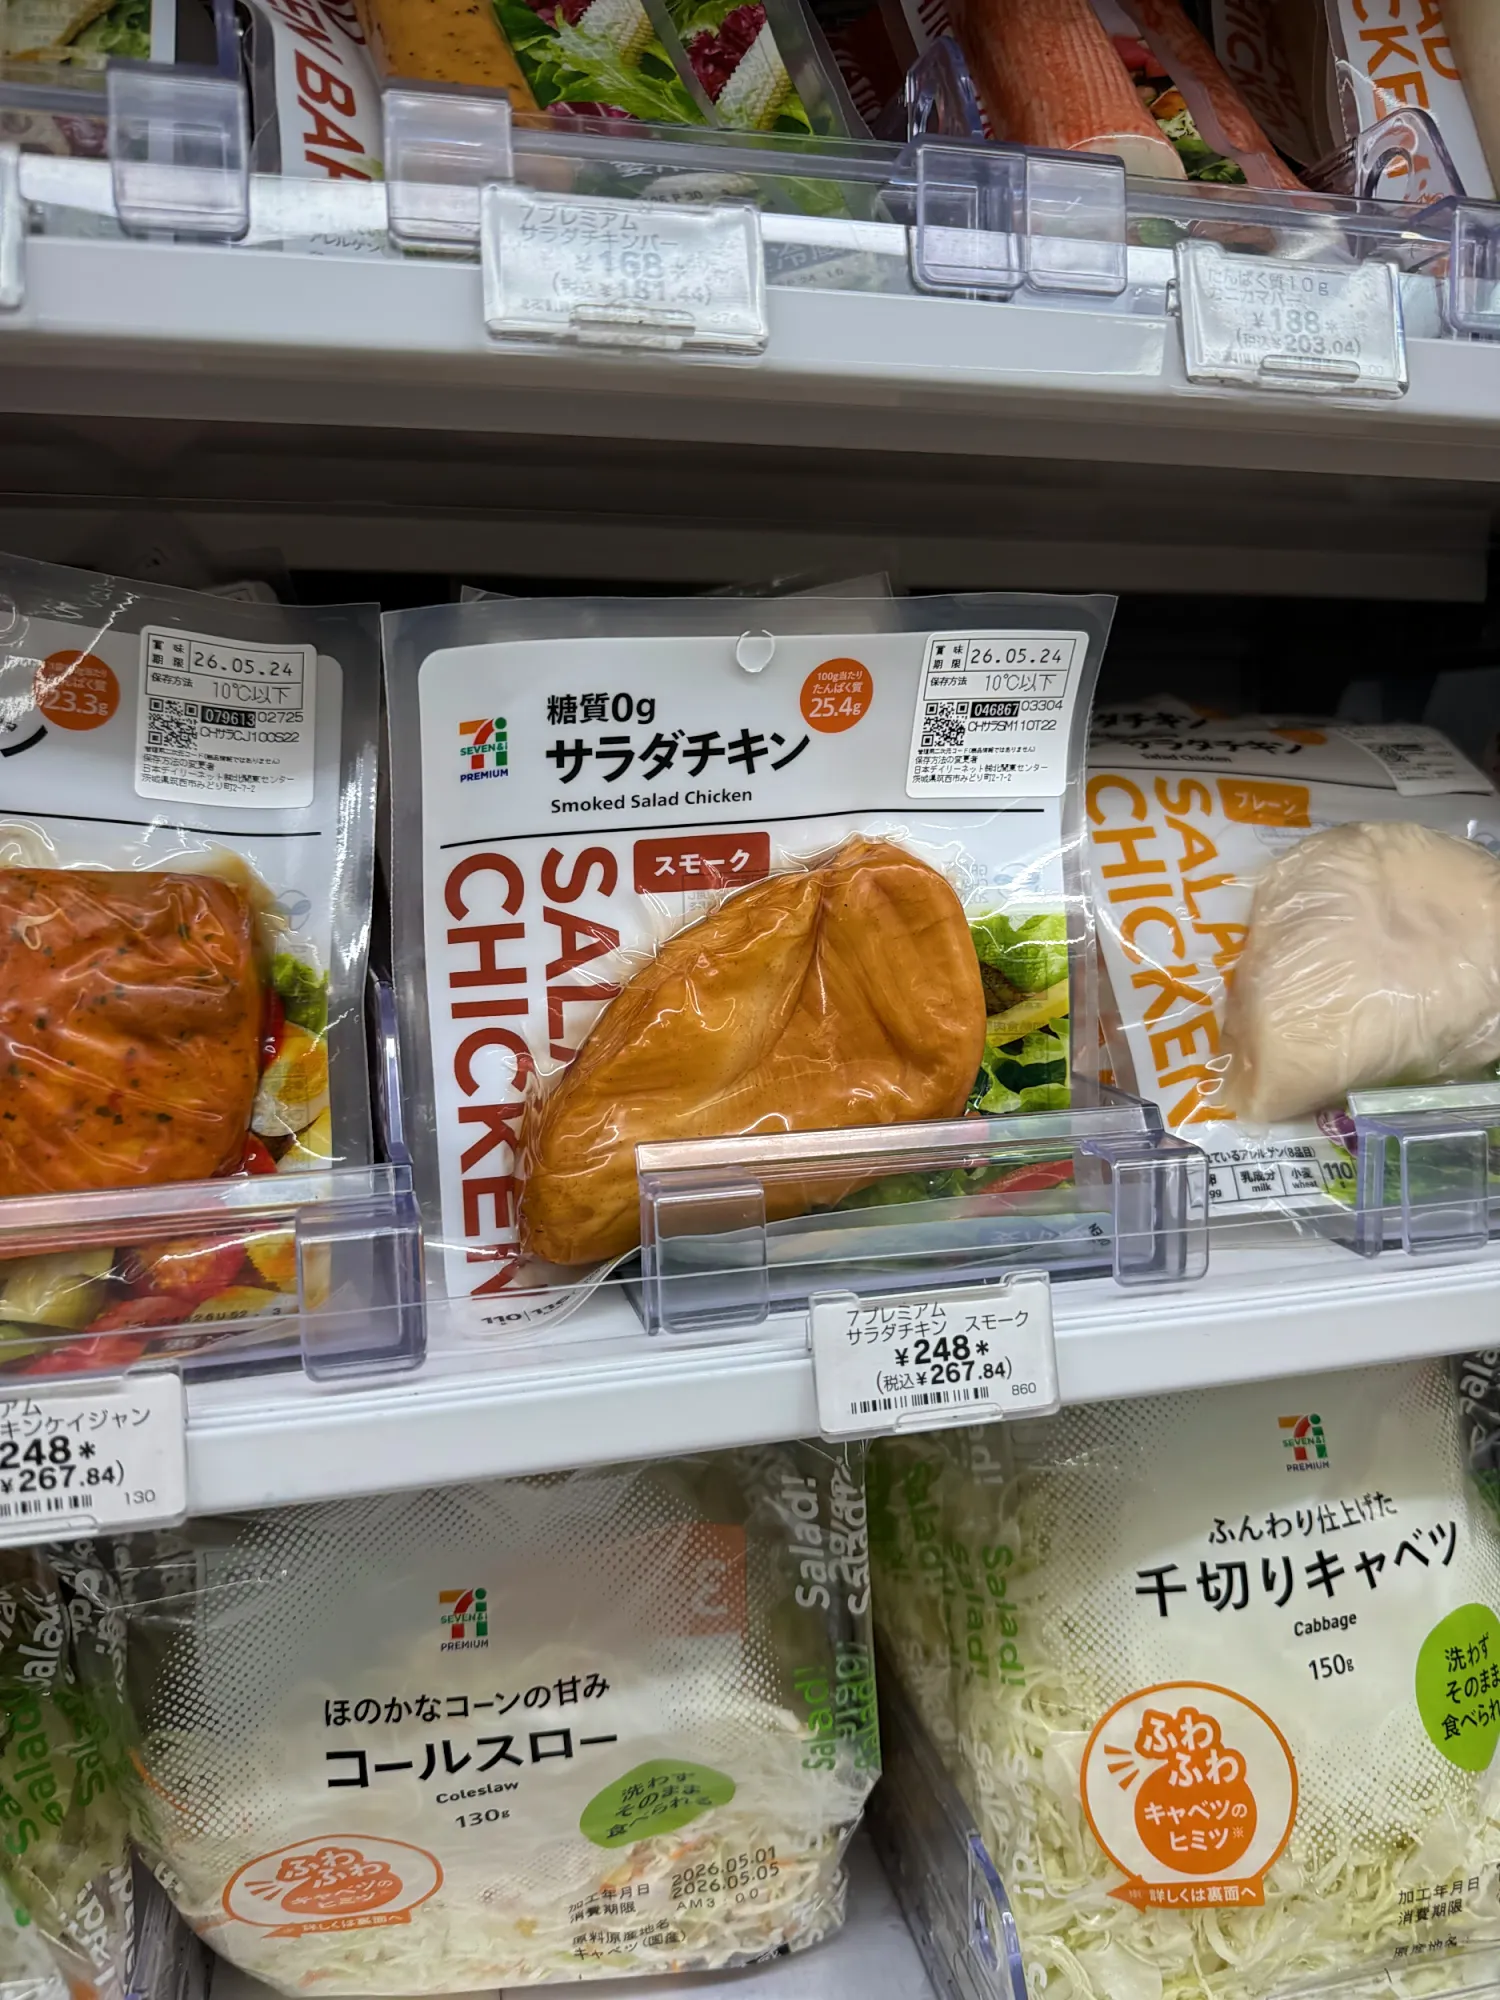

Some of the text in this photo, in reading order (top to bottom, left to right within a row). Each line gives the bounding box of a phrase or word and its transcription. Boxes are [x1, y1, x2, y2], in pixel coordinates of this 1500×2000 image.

[519, 222, 679, 250] サラダチキンバー
[152, 640, 185, 655] 賞味
[936, 644, 963, 656] 賞味
[970, 648, 1062, 664] 26.05.24
[194, 652, 293, 677] 26.05.24
[817, 670, 863, 682] 100g当たり
[933, 658, 961, 669] 期限
[151, 673, 194, 689] 保存方法
[212, 681, 291, 705] 10℃以下
[812, 681, 863, 694] たんぱく質
[930, 676, 967, 686] 保存方法
[985, 673, 1057, 692] 10℃以下
[43, 688, 109, 716] 23.3g
[546, 692, 656, 726] 糖質0g
[809, 696, 862, 718] 25.4g
[973, 700, 1062, 717] 046867 03304
[205, 708, 304, 727] 079613 02725
[546, 728, 811, 785] サラダチキン
[915, 755, 978, 765] 保存方法の変更者
[1141, 752, 1232, 764] Salad Chicken
[460, 768, 508, 783] PREMIUM
[551, 787, 753, 813] Smoked Salad Chicken
[653, 848, 751, 876] スモーク
[1086, 774, 1237, 1127] CHICKEN
[1240, 1166, 1314, 1183] 乳成分 小麦
[1323, 1162, 1354, 1181] 110
[1251, 1182, 1272, 1193] milk
[1292, 1180, 1319, 1190] wheat
[847, 1302, 946, 1327] 7プレミアム
[846, 1310, 1029, 1346] サラダチキン スモーク
[876, 1357, 1013, 1395] (税込¥267.84)
[1011, 1382, 1037, 1396] 860
[1286, 1460, 1330, 1472] PREMIUM
[124, 1489, 156, 1505] 130
[1208, 1490, 1398, 1544] ふんわり仕上げた
[781, 1475, 831, 1611] Salad!
[1135, 1521, 1457, 1618] 千切りキャベツ
[1293, 1612, 1358, 1637] Cabbage
[440, 1638, 489, 1652] PREMIUM
[1444, 1631, 1490, 1673] 洗わず
[1308, 1653, 1355, 1681] 150g
[1446, 1663, 1500, 1704] そのまま
[324, 1672, 611, 1727] ほのかなコーンの甘み
[1143, 1714, 1215, 1751] ふわ
[326, 1728, 618, 1789] コールスロー
[1168, 1749, 1240, 1787] ふわ
[436, 1780, 519, 1805] Coleslaw
[454, 1808, 511, 1830] 130g
[1144, 1799, 1248, 1825] キャベツの
[284, 1850, 356, 1879] ふわ
[313, 1862, 383, 1889] ふわ
[568, 1845, 777, 1915] 加工年月日 2026.05.01
[569, 1861, 780, 1923] 消費期限 2026.05.05
[1397, 1876, 1480, 1905] 加工年月日
[1398, 1898, 1463, 1926] 消費期限
[572, 1918, 670, 1946] 原料原産地名
[573, 1929, 687, 1960] キャベツ(国産)
